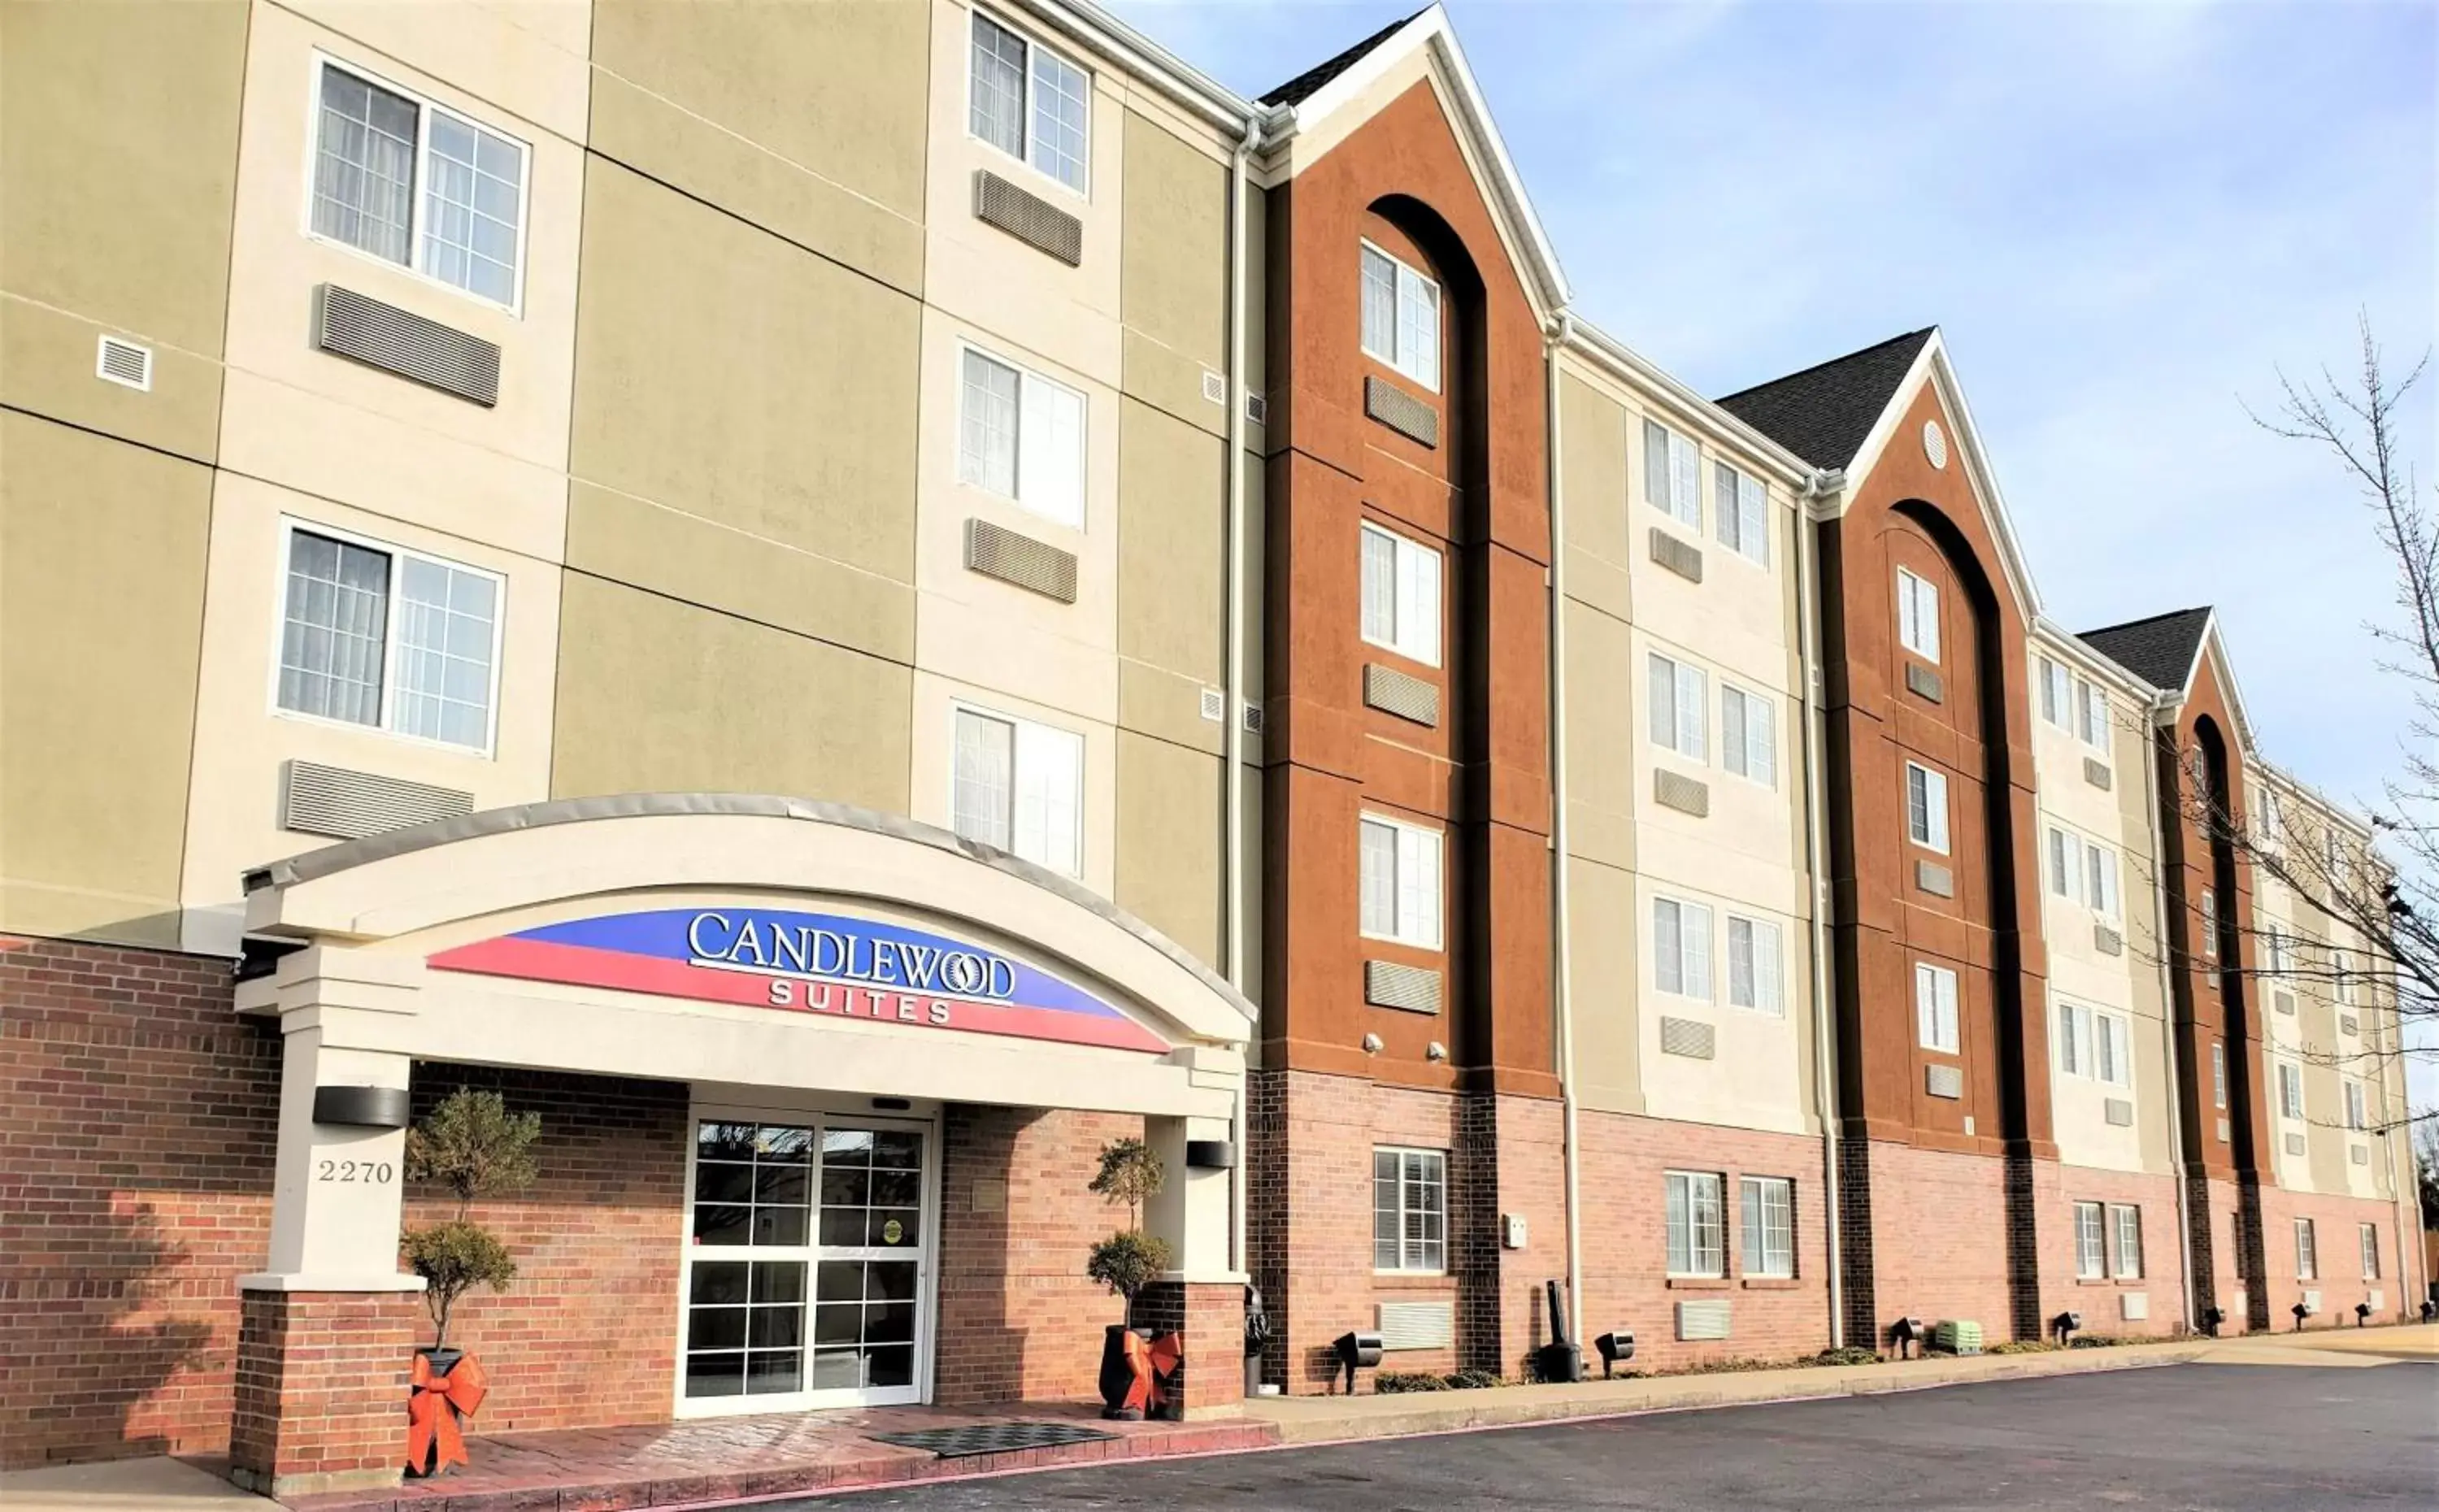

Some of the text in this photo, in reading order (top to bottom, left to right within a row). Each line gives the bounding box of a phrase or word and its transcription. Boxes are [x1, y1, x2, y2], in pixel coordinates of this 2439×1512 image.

[688, 912, 1015, 998] CANDLEWOOD
[769, 980, 950, 1024] SUITES
[319, 1160, 392, 1184] 2270
